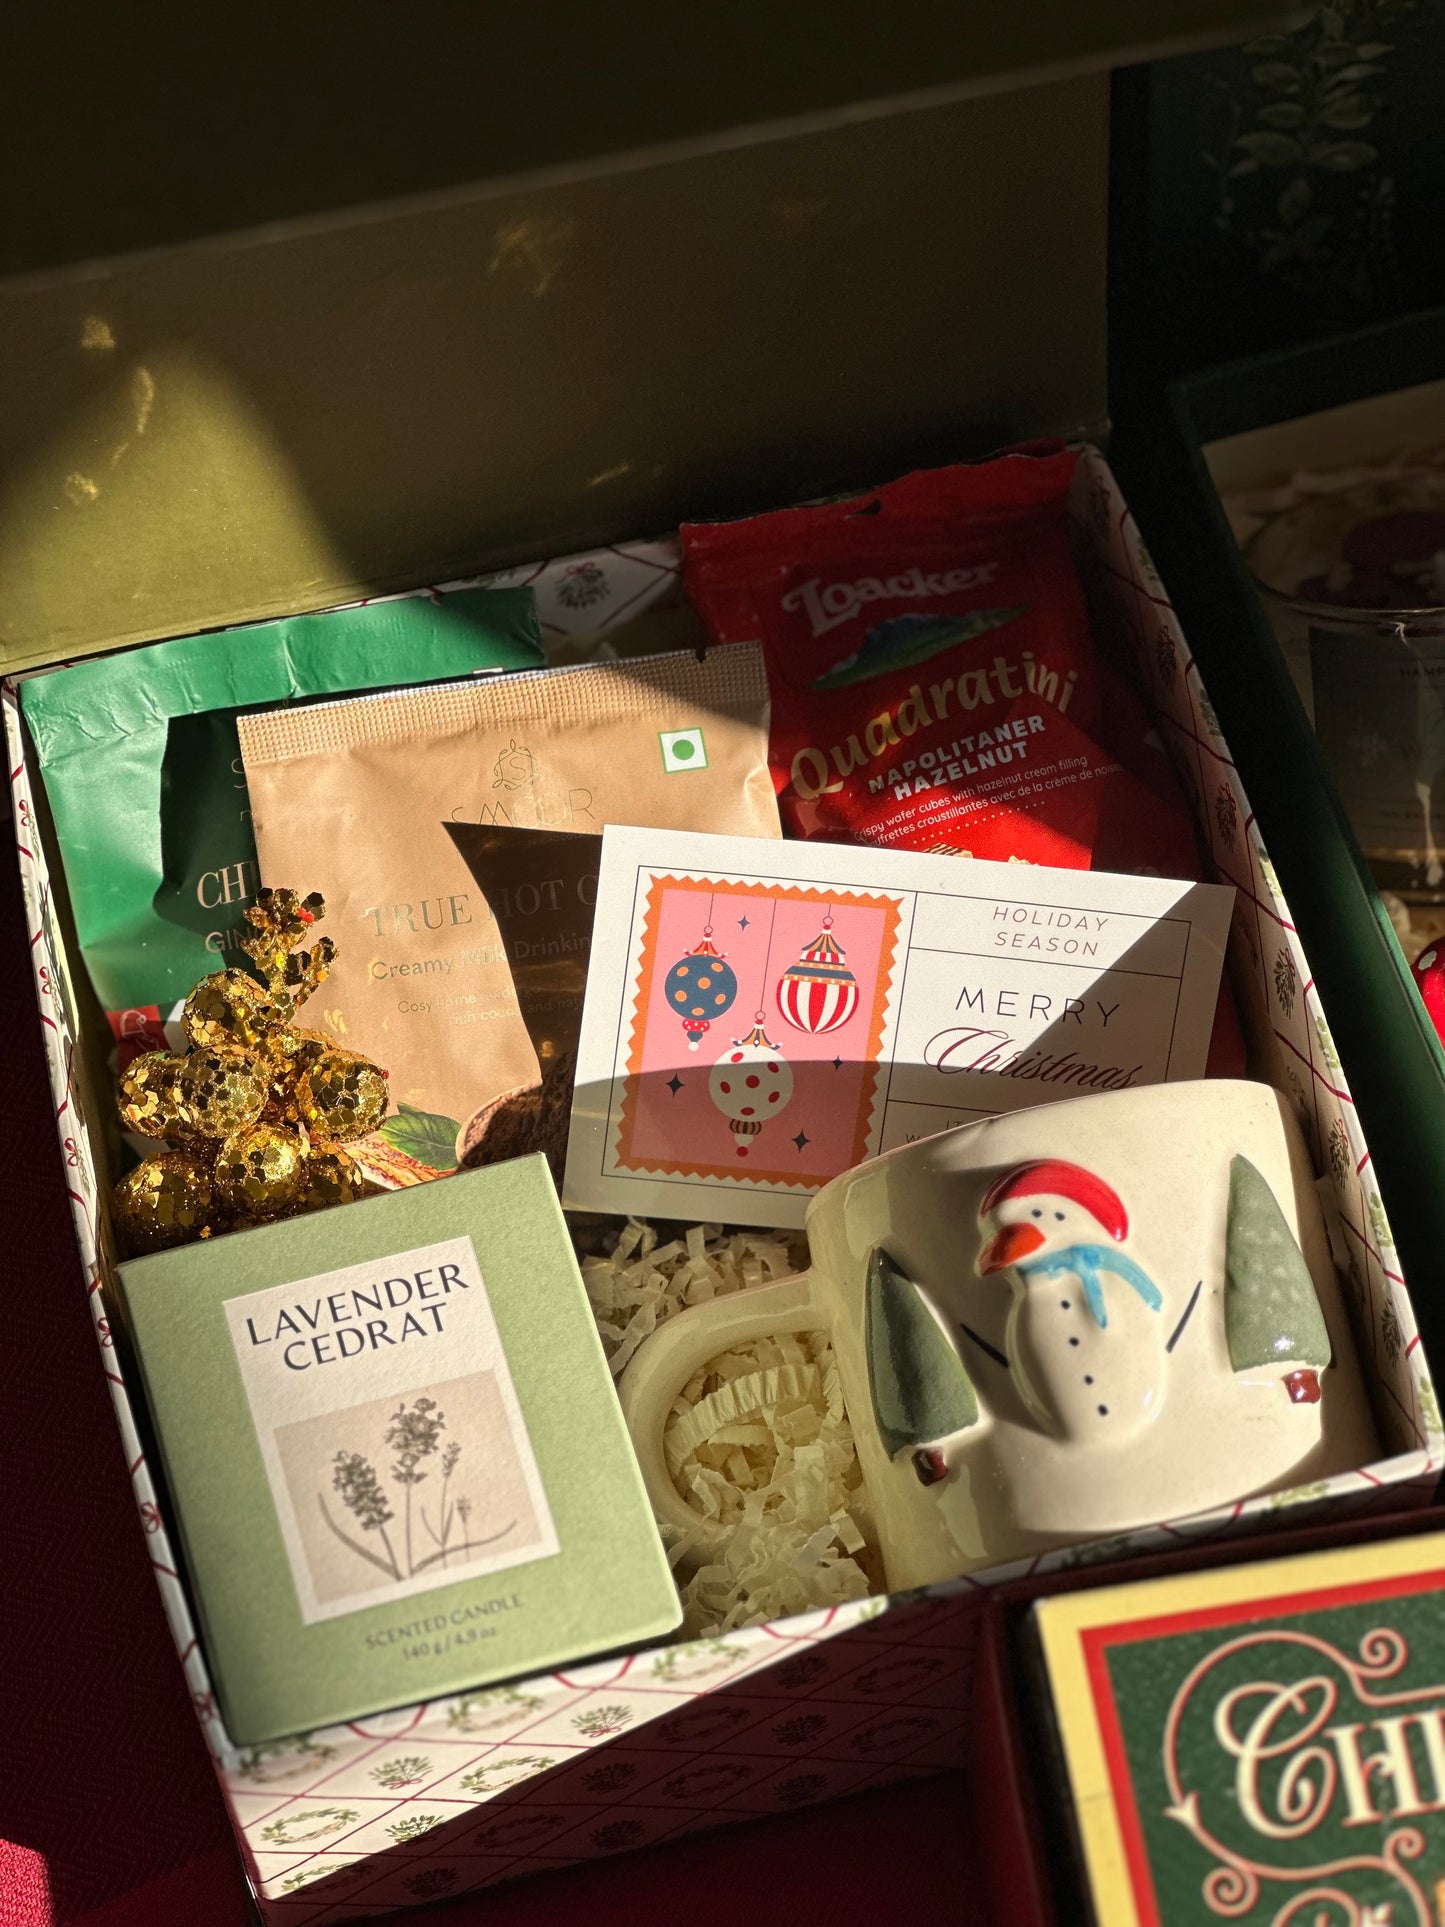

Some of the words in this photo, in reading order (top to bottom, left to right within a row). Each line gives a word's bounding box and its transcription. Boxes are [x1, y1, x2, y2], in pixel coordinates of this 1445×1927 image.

[781, 560, 1000, 638] Loacker
[790, 650, 1080, 801] Quadratini
[867, 714, 1047, 795] NAPOLITANER
[886, 808, 917, 827] wafer
[918, 796, 951, 814] cubes
[952, 788, 976, 801] with
[976, 772, 1022, 794] hazelnut
[1024, 764, 1057, 780] cream
[1058, 756, 1088, 771] filling
[893, 741, 1028, 801] HAZELNUT
[868, 823, 915, 848] ufrettes
[917, 798, 989, 829] croustillantes
[990, 790, 1016, 804] avec
[1017, 785, 1031, 796] de
[1032, 782, 1043, 793] la
[1045, 774, 1077, 790] crème
[1079, 769, 1093, 780] de
[365, 893, 473, 937] TRUE
[487, 879, 565, 920] HOT
[992, 906, 1109, 932] HOLIDAY
[371, 957, 453, 980] Creamy
[513, 932, 592, 960] Drinkin
[994, 931, 1098, 956] SEASON
[398, 1000, 433, 1015] Cosy
[955, 986, 1120, 1027] MERRY
[923, 1027, 1143, 1089] Christmas
[246, 1262, 469, 1347] LAVENDER
[283, 1302, 448, 1371] CEDRAT
[365, 1614, 447, 1650] SCENTED
[450, 1593, 523, 1625] CANDLE
